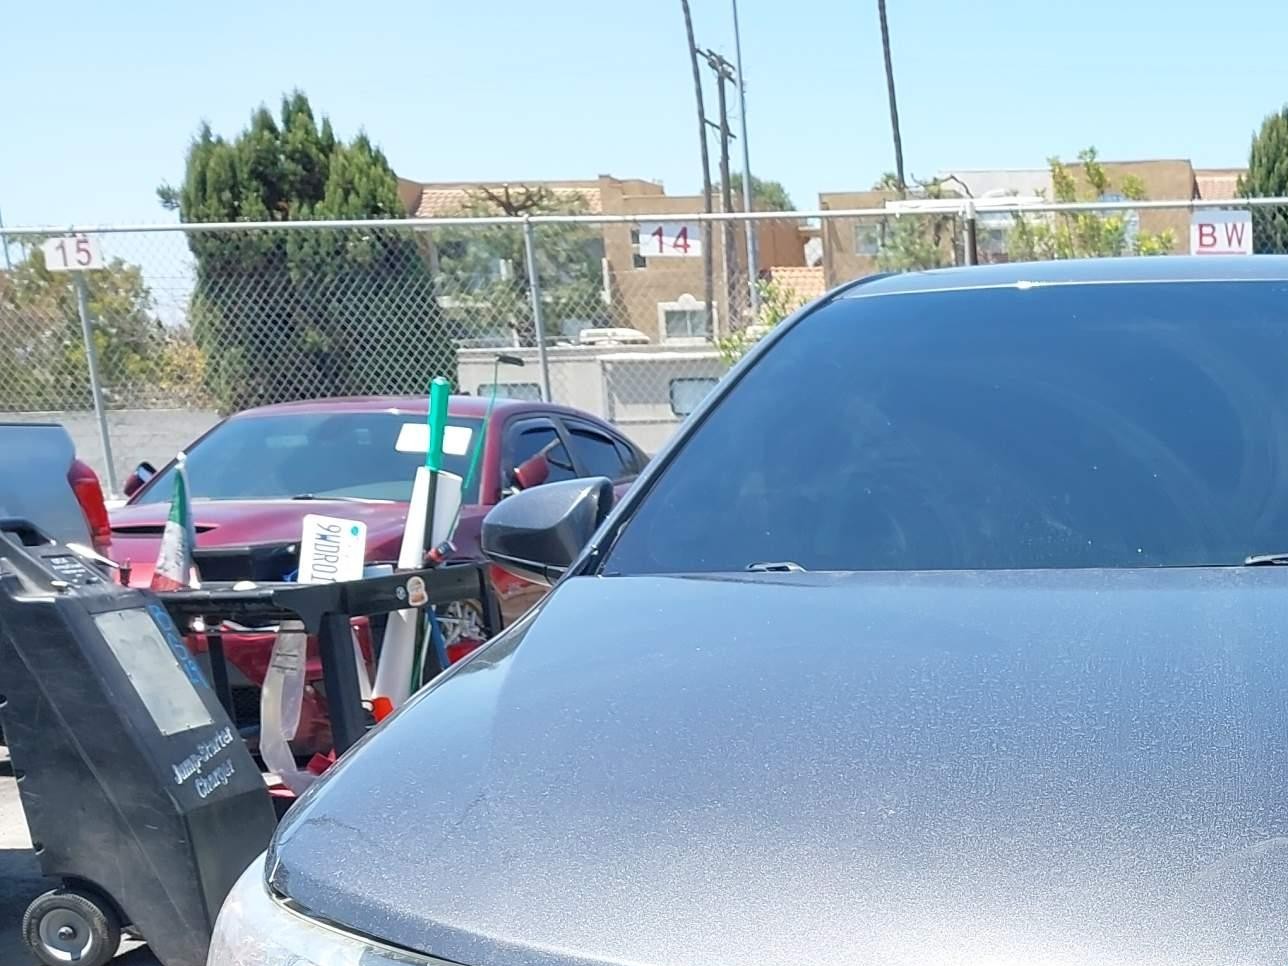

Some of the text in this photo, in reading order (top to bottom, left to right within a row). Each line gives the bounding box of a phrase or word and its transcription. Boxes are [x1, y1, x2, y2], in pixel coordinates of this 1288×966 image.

[651, 226, 691, 253] 14
[1198, 223, 1245, 248] BW
[55, 240, 92, 267] 15
[195, 758, 235, 798] Charger
